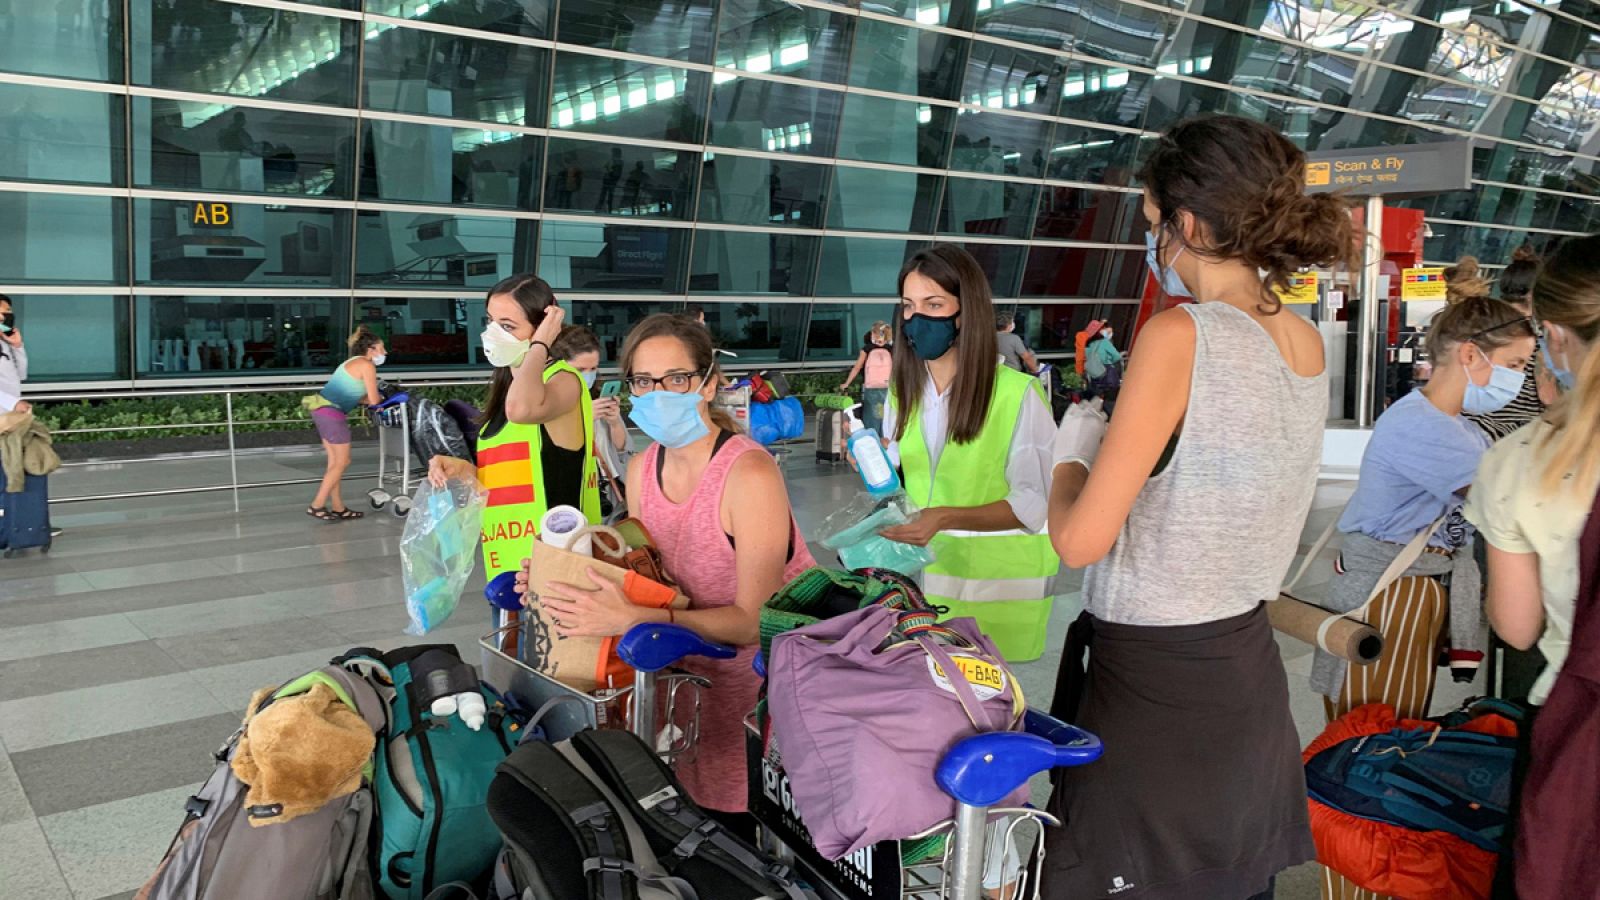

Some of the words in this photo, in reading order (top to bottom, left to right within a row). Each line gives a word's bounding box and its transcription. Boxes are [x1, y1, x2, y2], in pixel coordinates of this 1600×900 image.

[1335, 160, 1367, 172] Scan
[1371, 158, 1382, 170] &
[1385, 156, 1405, 171] Fly
[194, 202, 229, 225] AB
[490, 551, 501, 568] E
